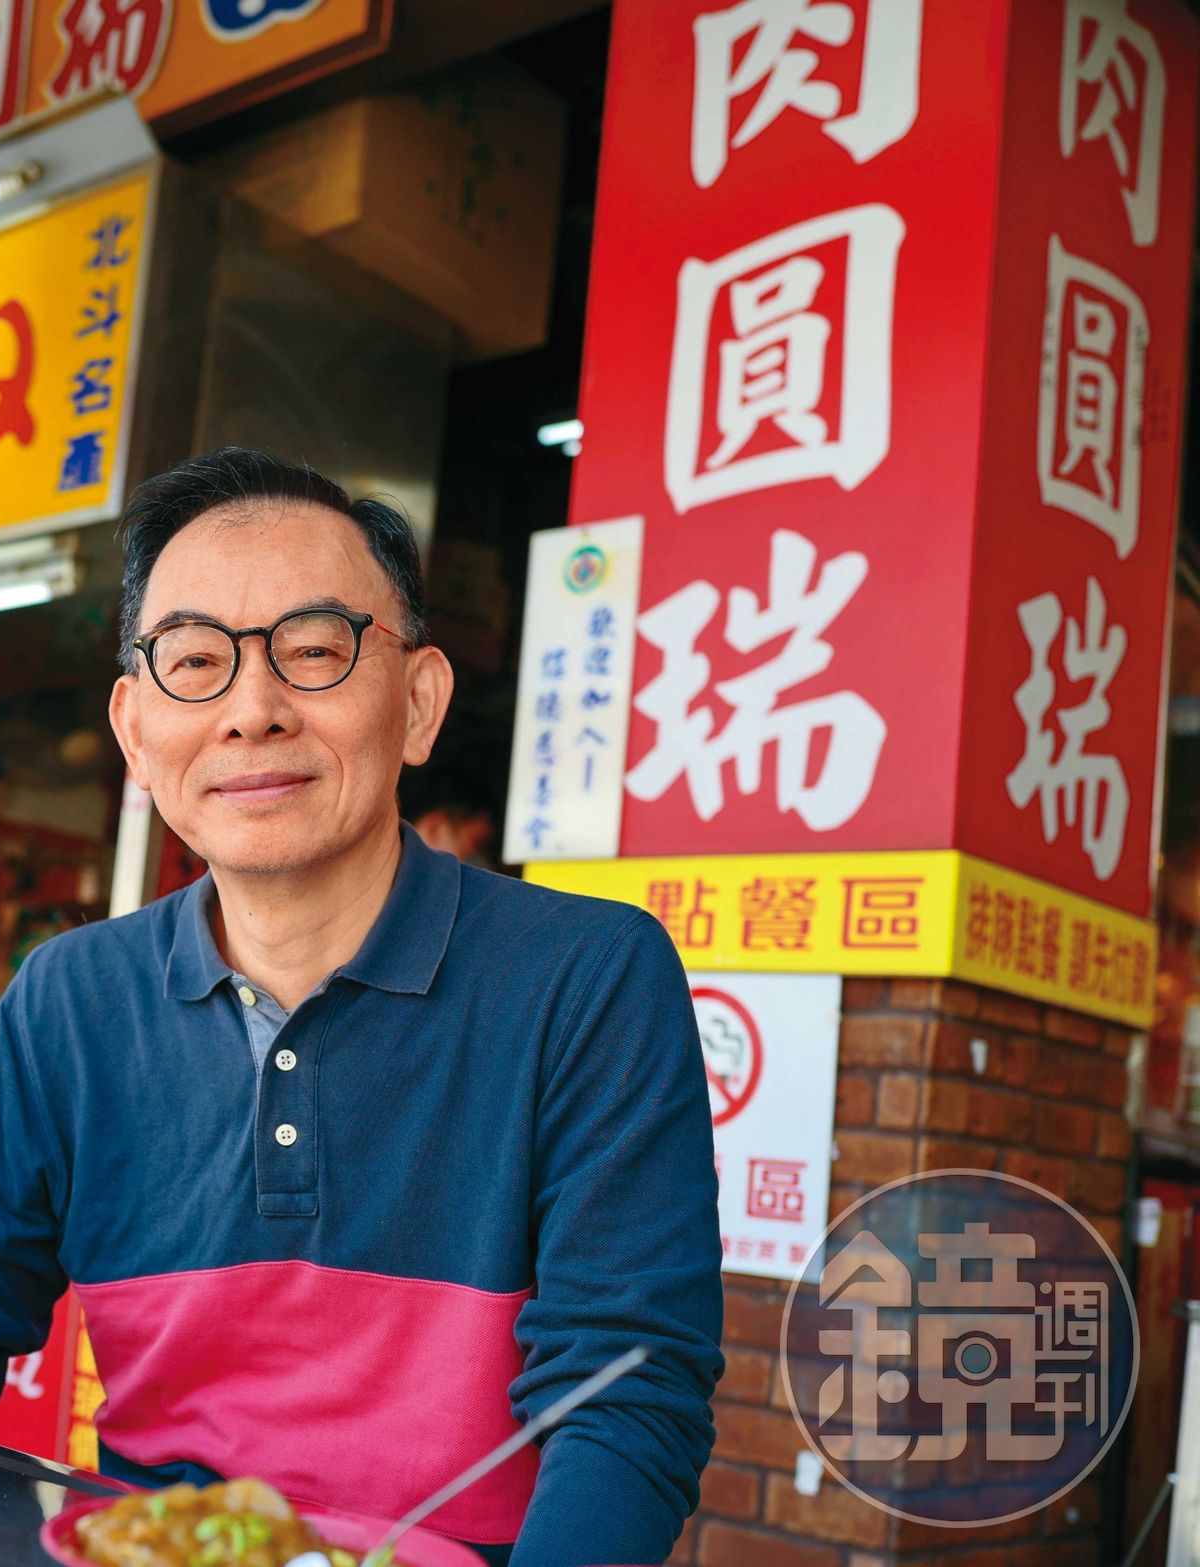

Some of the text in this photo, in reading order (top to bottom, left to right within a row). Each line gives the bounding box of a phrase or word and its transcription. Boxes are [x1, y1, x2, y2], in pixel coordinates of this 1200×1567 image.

[56, 214, 135, 495] 北斗名產
[625, 0, 922, 832] 肉圓瑞
[1005, 0, 1167, 881] 肉圓瑞
[647, 876, 925, 951] 點餐區
[713, 1153, 809, 1224] 區
